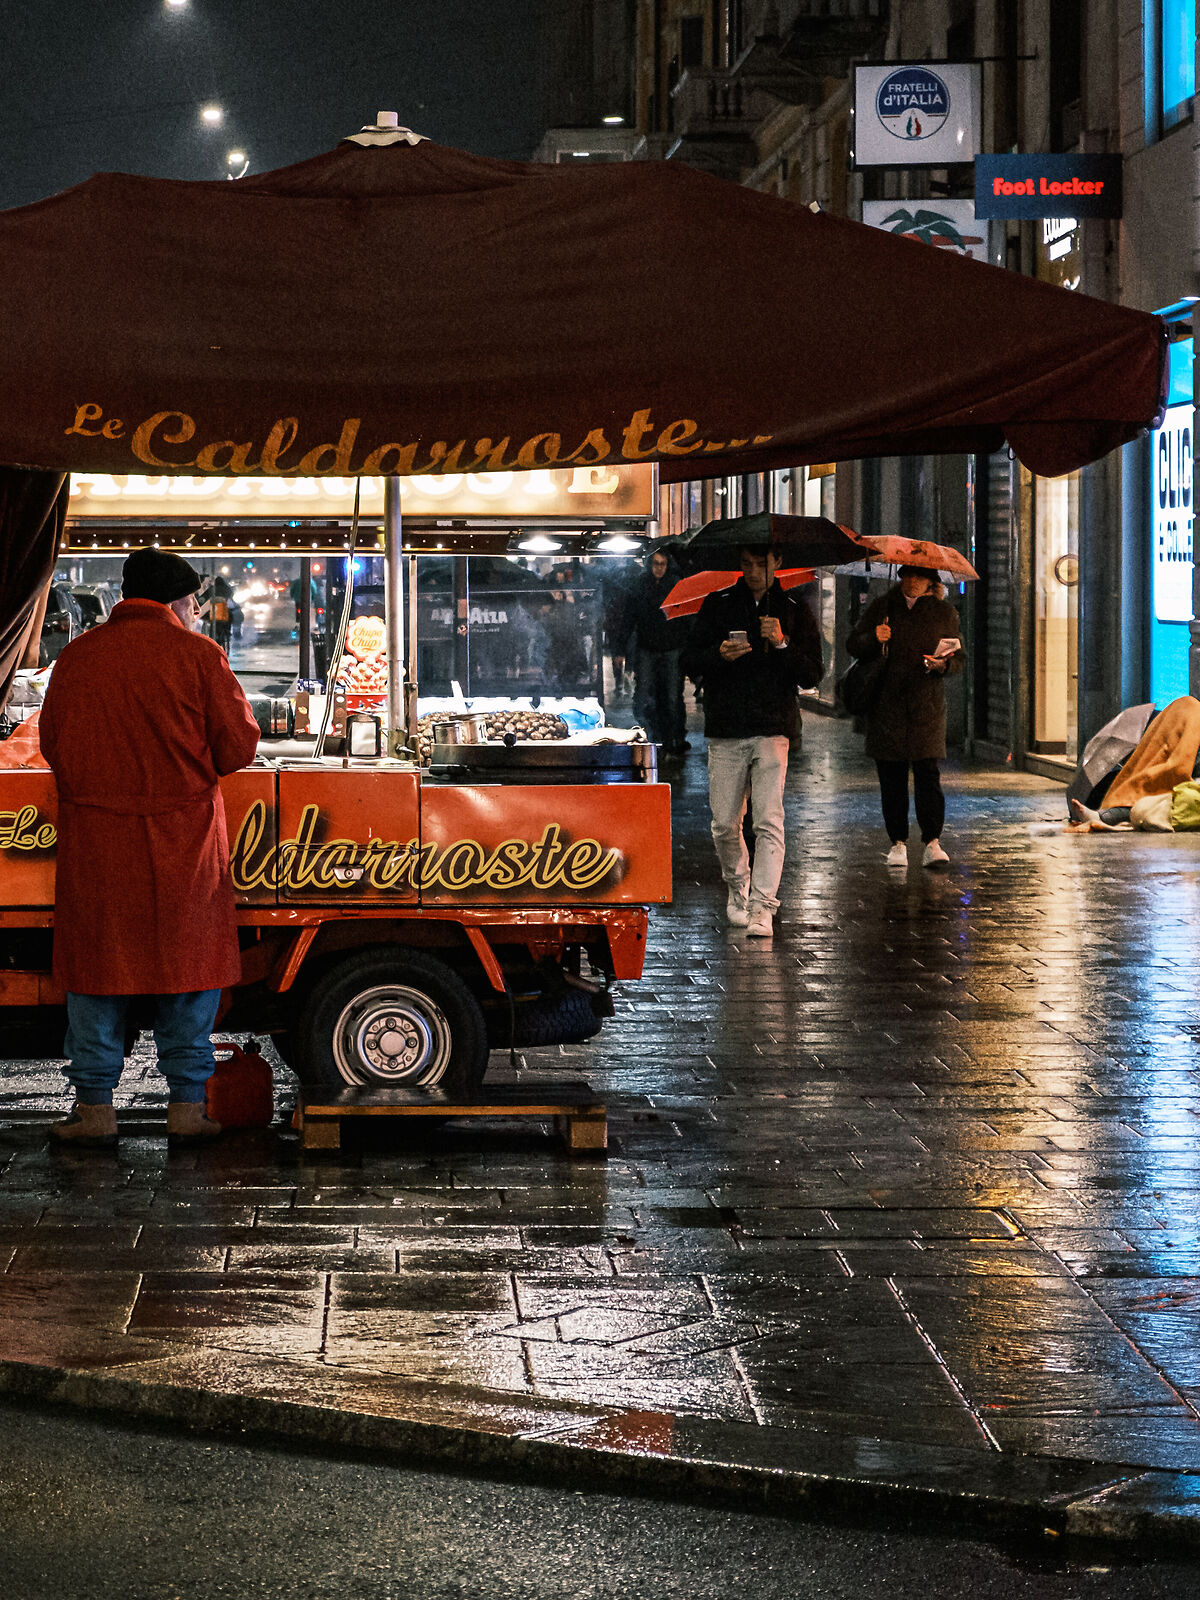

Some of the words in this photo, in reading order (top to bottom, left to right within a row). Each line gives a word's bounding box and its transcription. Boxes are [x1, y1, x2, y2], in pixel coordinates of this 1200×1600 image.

[888, 83, 938, 92] FRATELLI
[883, 94, 943, 106] d'ITALIA
[1039, 177, 1104, 196] Locker
[64, 403, 126, 440] Le
[229, 798, 620, 890] ldarroste
